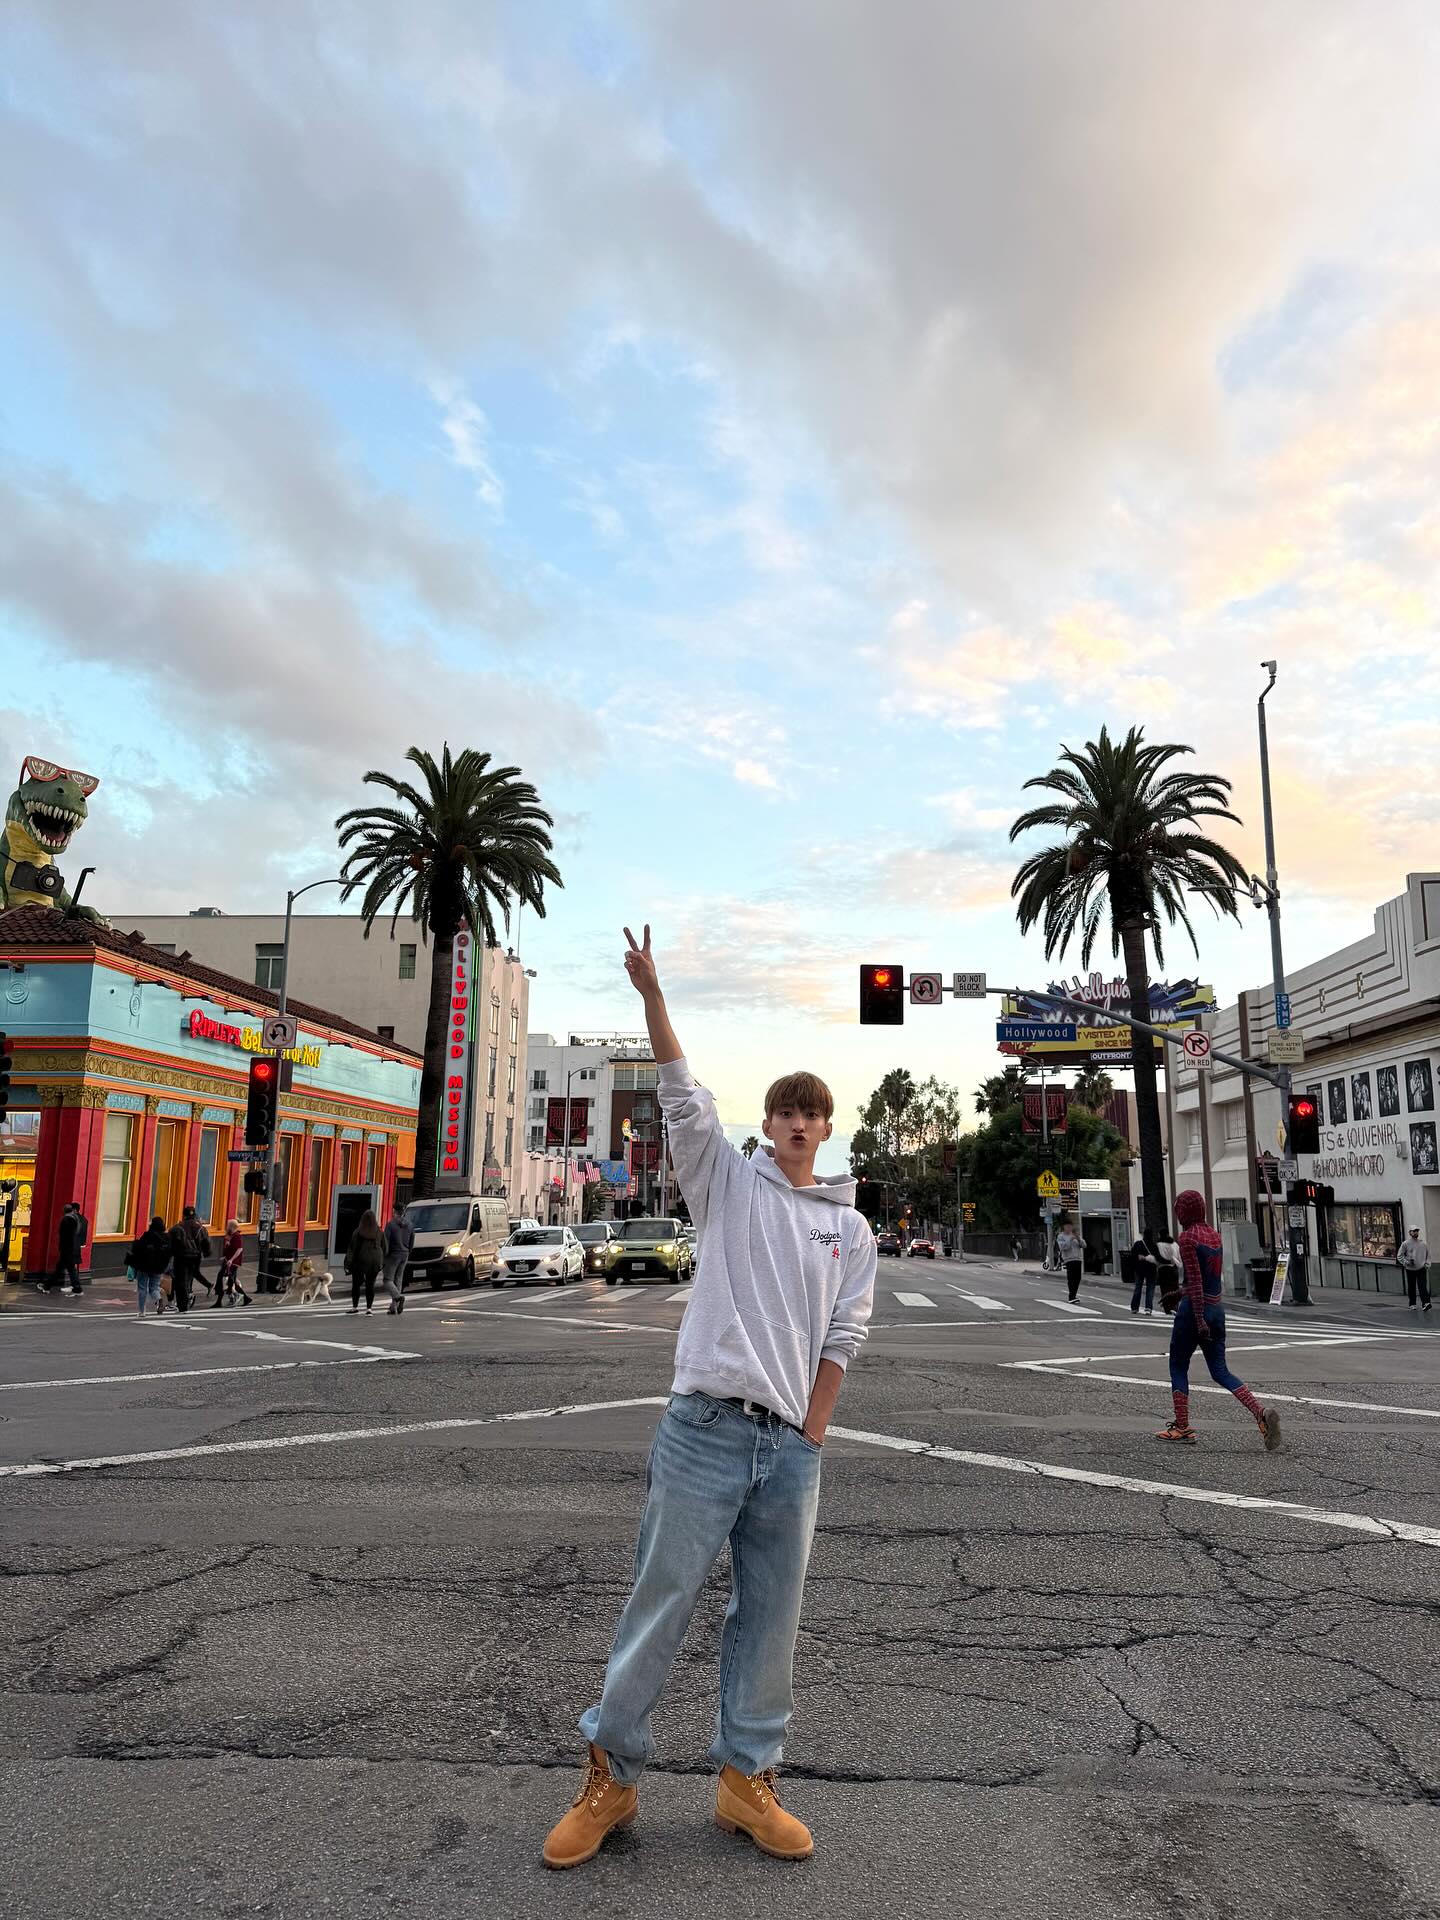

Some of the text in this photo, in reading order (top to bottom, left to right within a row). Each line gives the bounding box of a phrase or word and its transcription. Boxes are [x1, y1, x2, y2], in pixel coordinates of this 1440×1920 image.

[1005, 1027, 1068, 1040] Hollywood
[1083, 1031, 1115, 1039] VISITED
[1094, 1040, 1118, 1048] SINCE
[444, 1075, 463, 1171] MUSEUM
[1346, 1122, 1398, 1149] SOUVENIRS
